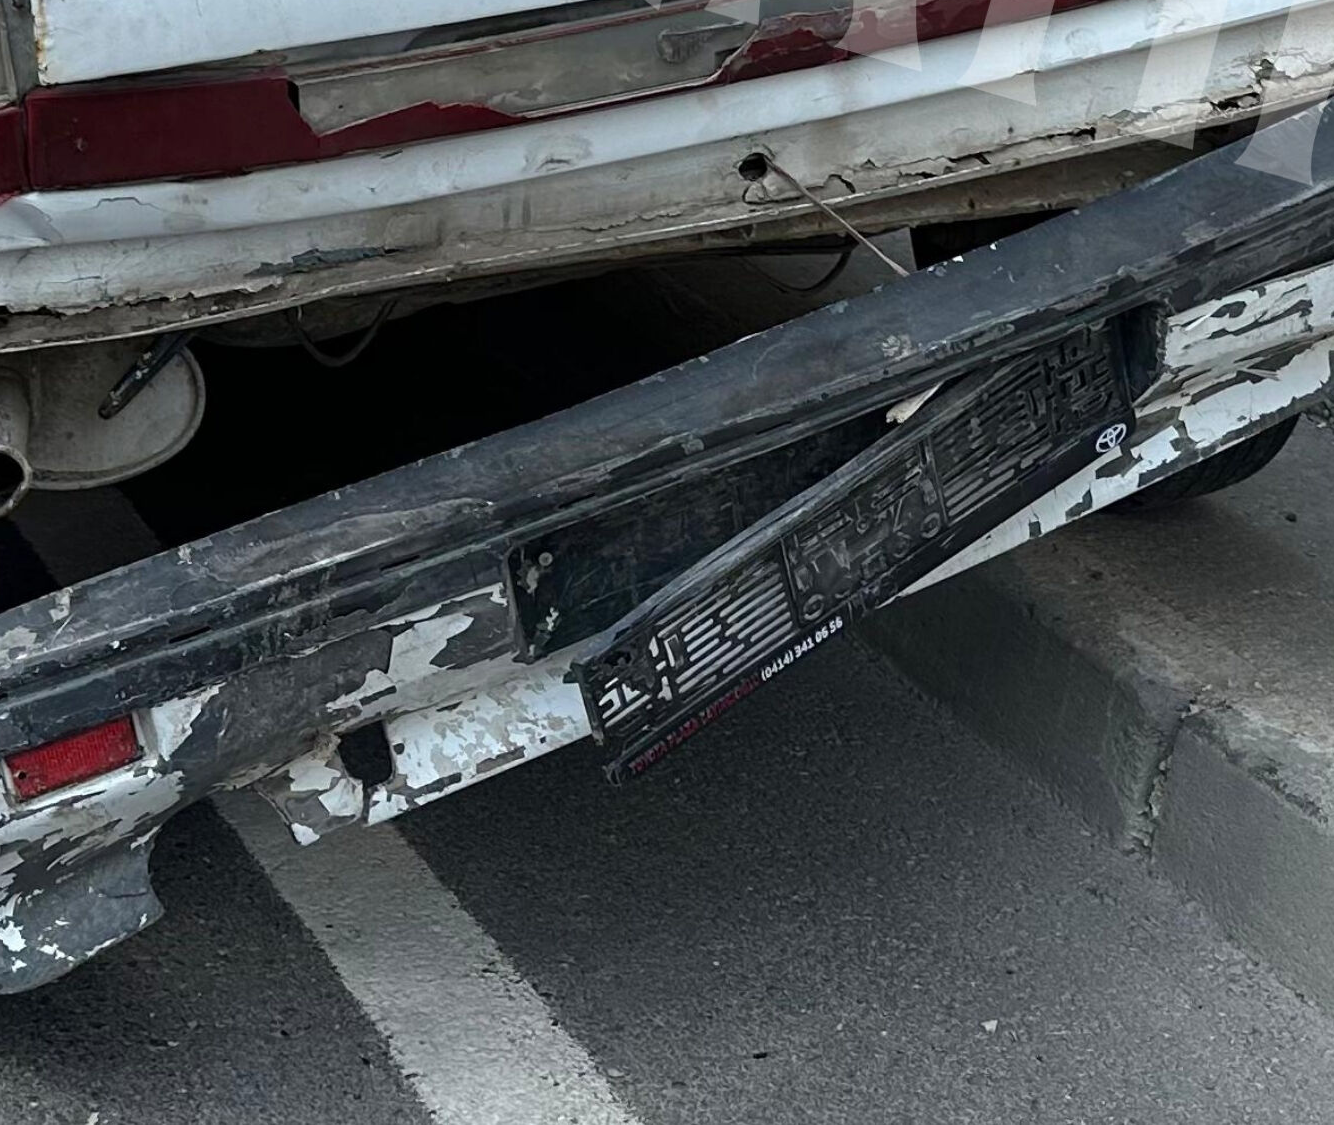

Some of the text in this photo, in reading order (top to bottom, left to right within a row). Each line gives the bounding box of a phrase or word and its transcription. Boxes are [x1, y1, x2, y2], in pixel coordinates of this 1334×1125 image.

[761, 650, 794, 681] (0414)
[794, 637, 815, 659] 341
[829, 616, 843, 634] 56
